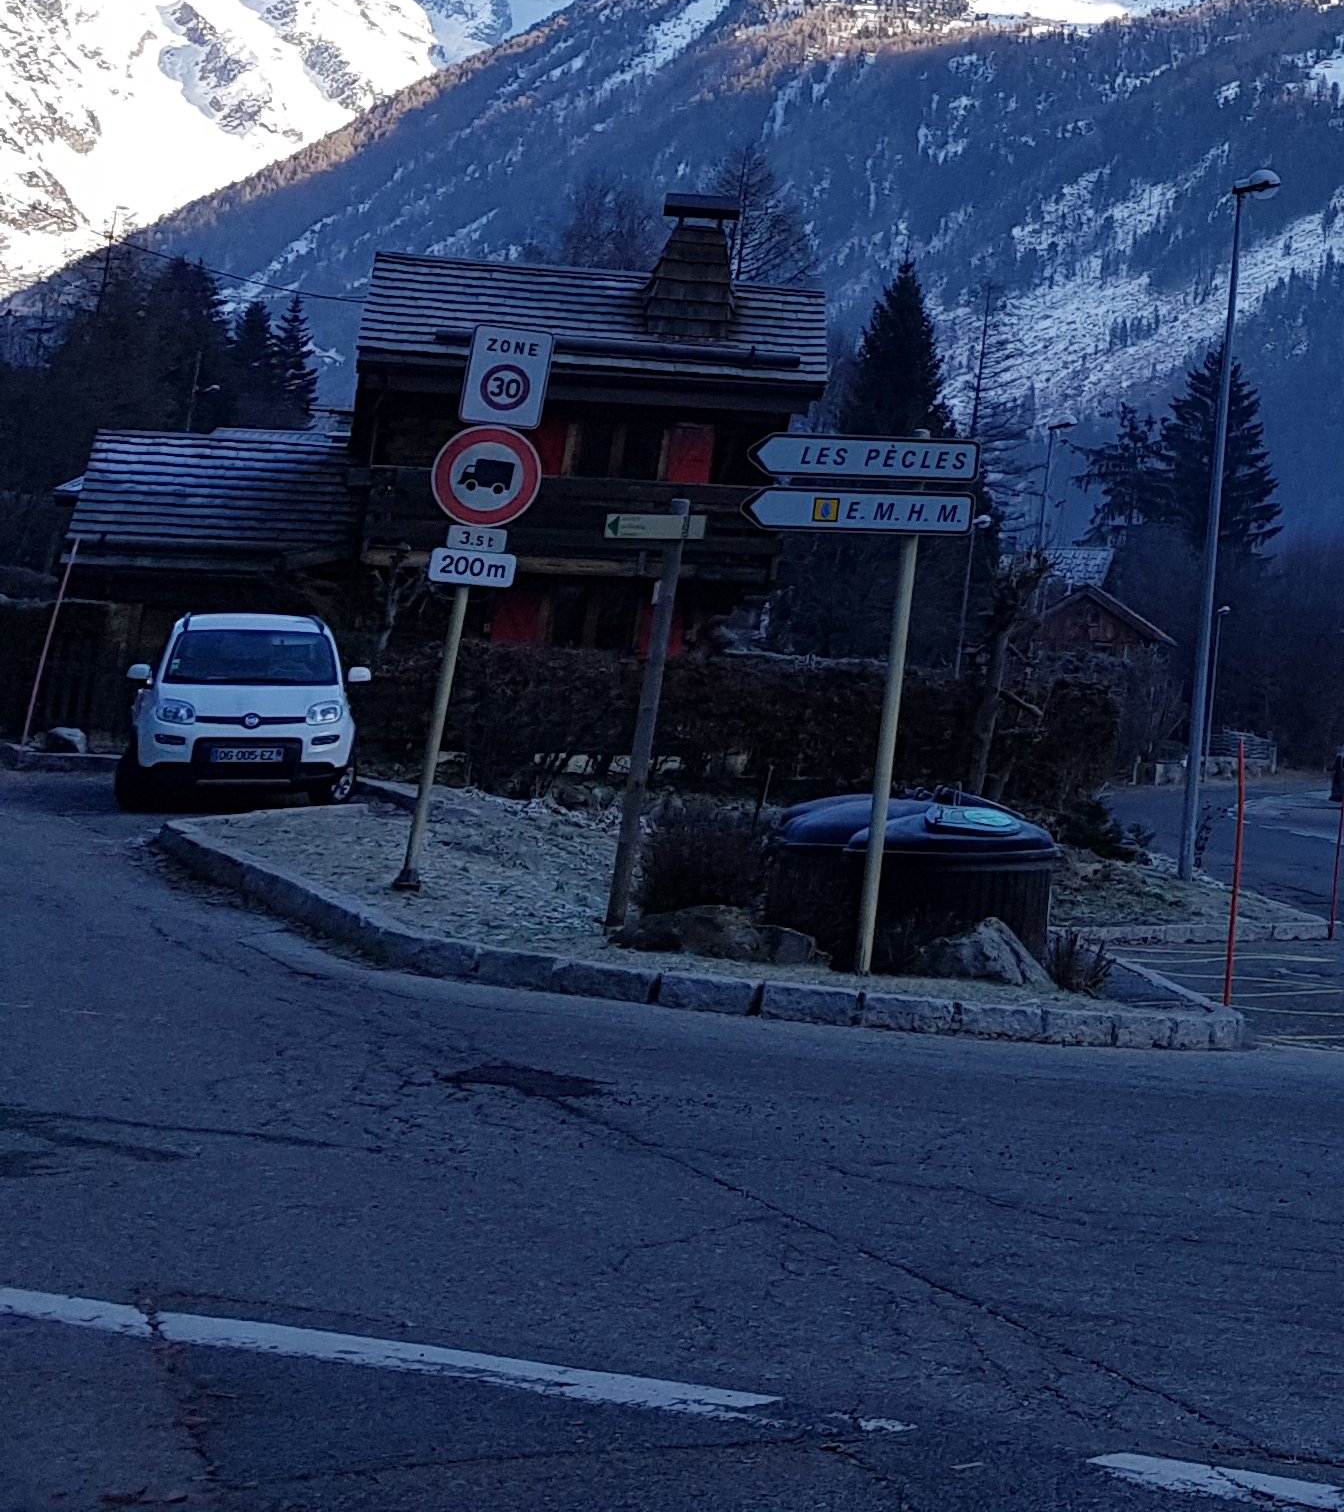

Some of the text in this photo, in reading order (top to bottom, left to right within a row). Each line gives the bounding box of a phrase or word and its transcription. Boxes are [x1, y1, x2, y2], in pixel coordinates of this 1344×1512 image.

[487, 338, 539, 356] ZONE
[490, 377, 521, 399] 30
[800, 444, 967, 470] LES PÈCLES
[439, 554, 506, 579] 200m
